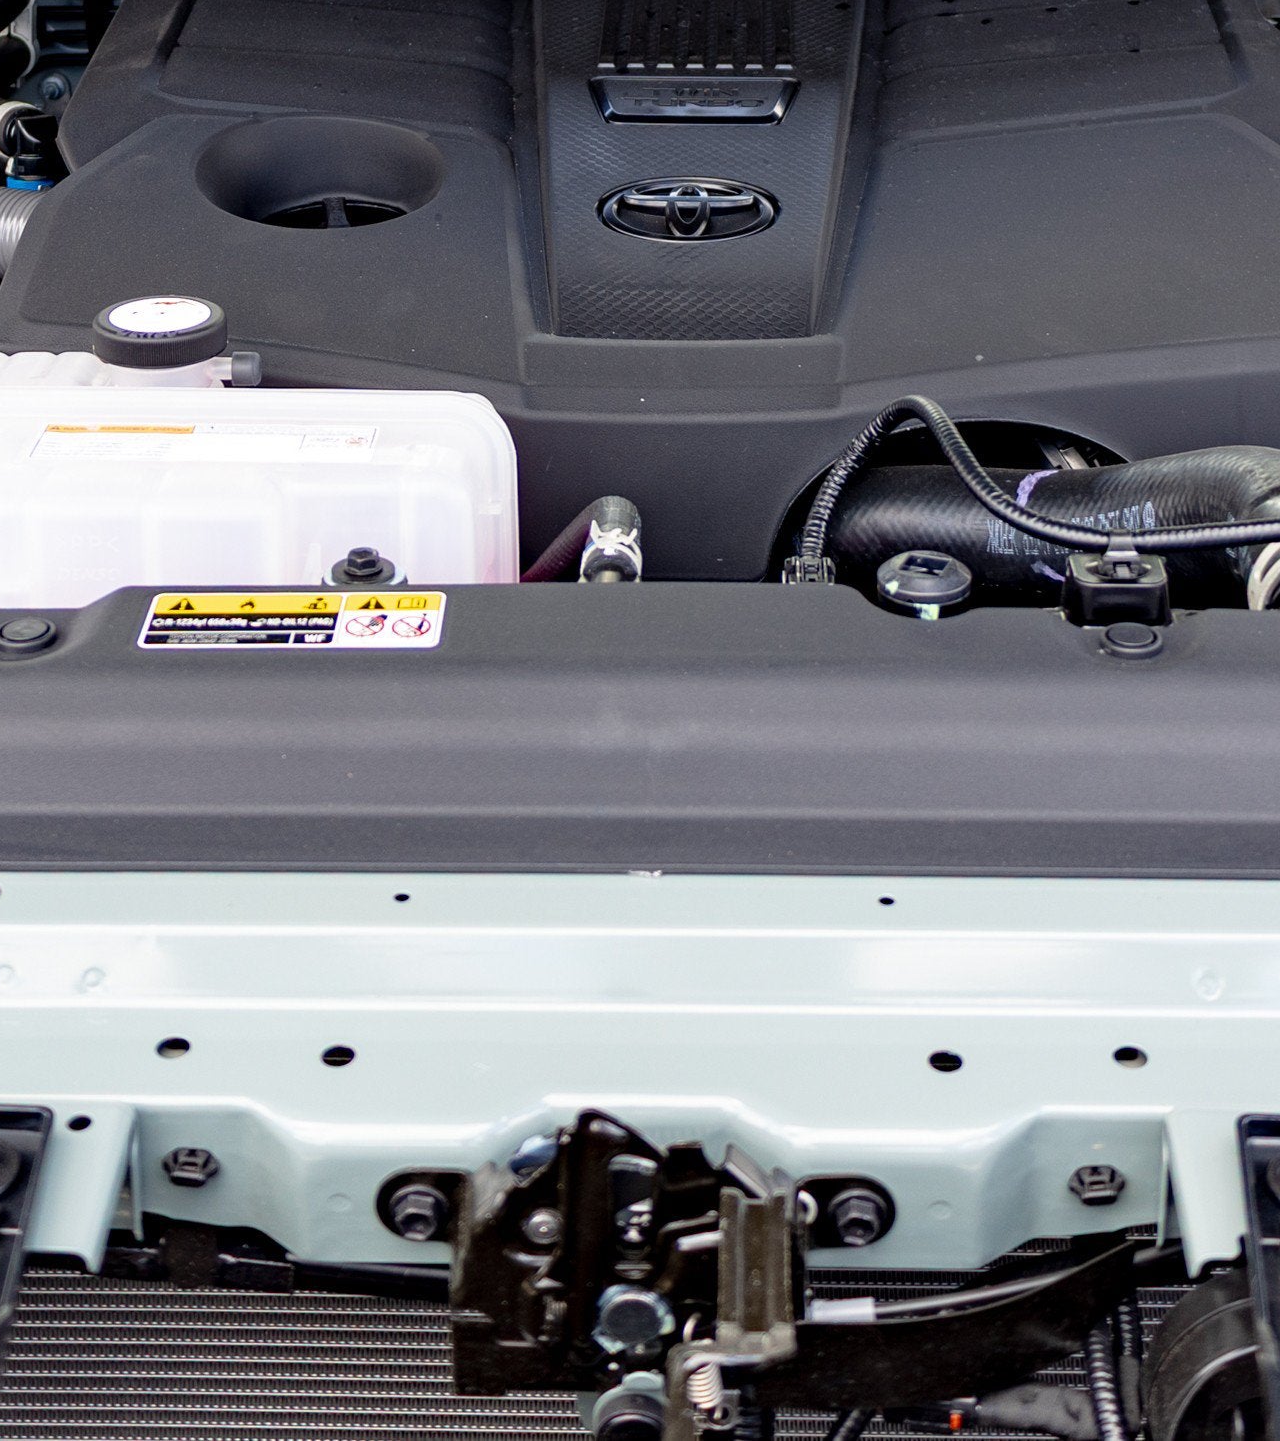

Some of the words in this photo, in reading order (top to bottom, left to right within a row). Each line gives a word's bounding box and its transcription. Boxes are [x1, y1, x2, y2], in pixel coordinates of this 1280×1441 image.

[642, 86, 740, 97] TWIN
[622, 96, 768, 108] TURBO
[303, 633, 327, 643] WF
